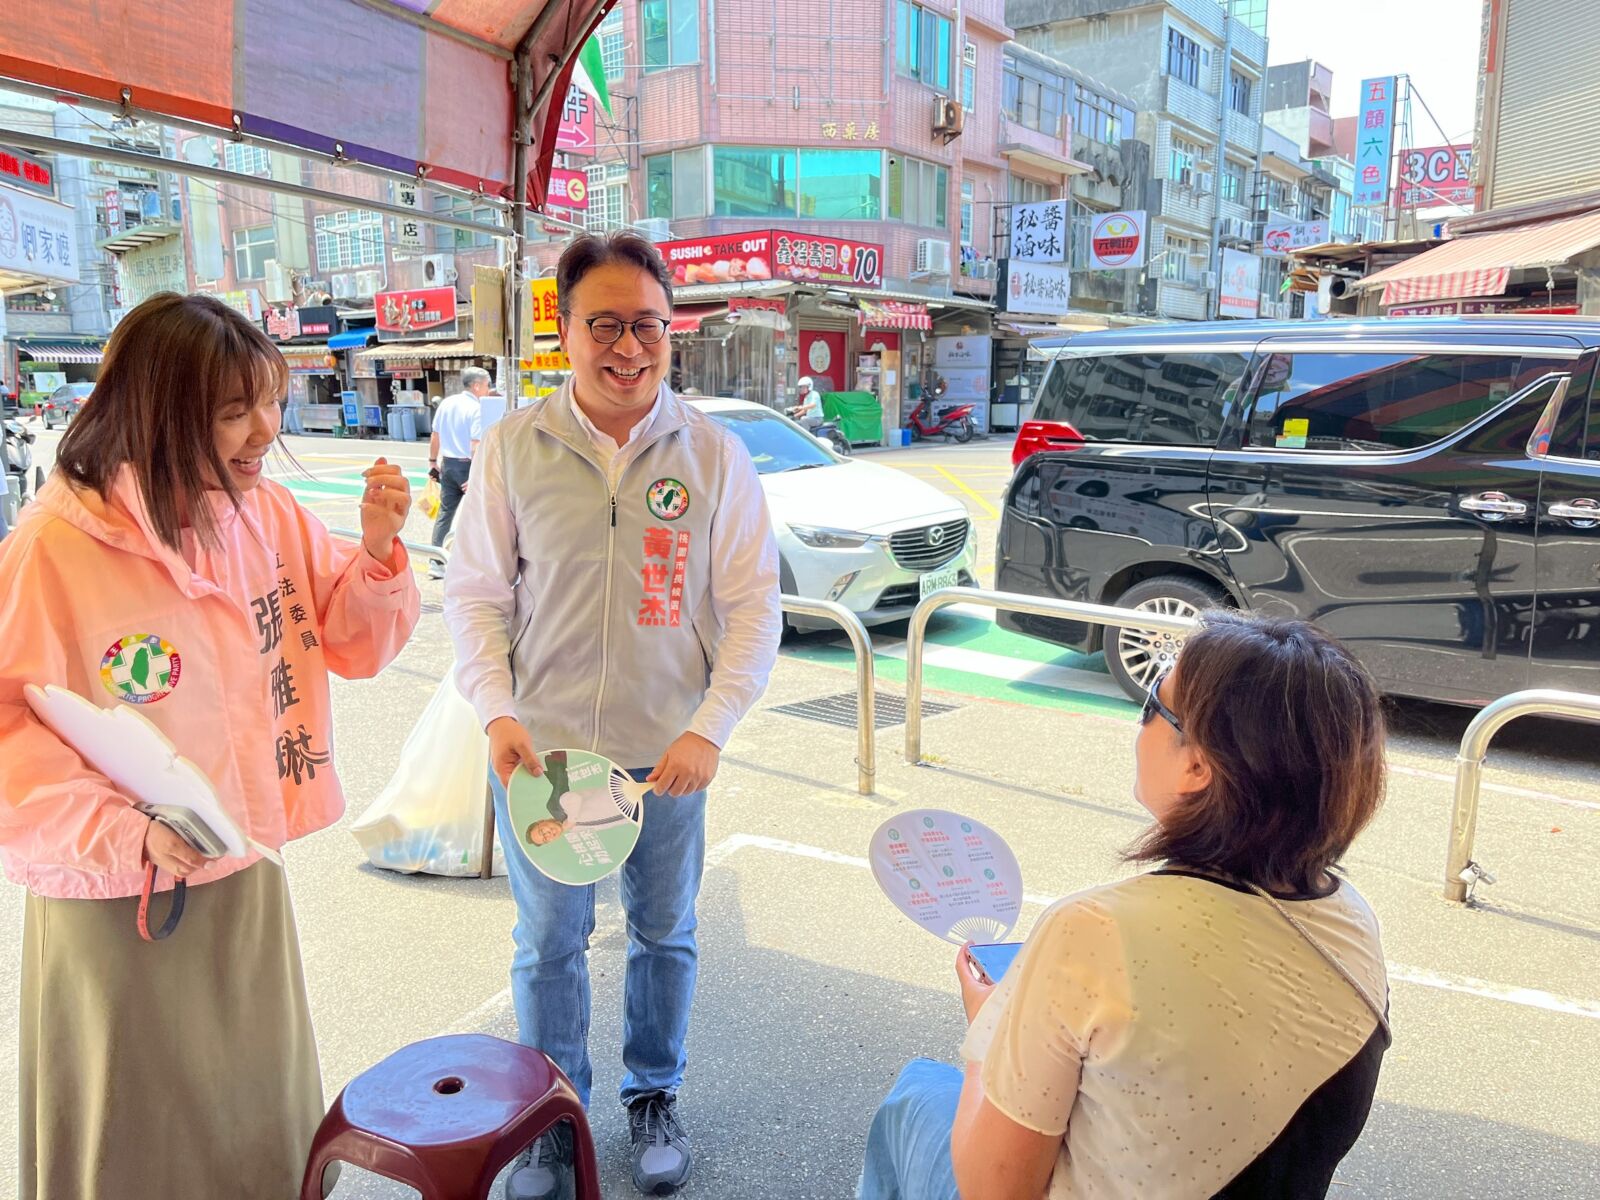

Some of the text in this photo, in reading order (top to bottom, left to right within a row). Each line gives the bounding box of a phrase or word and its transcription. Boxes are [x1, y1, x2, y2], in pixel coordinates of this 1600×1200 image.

[1361, 80, 1386, 185] 五顏六色
[670, 246, 703, 260] SUSHI
[1014, 233, 1061, 257] 滷味
[637, 526, 674, 626] 黃世杰
[669, 531, 690, 626] 桃園市長候選人
